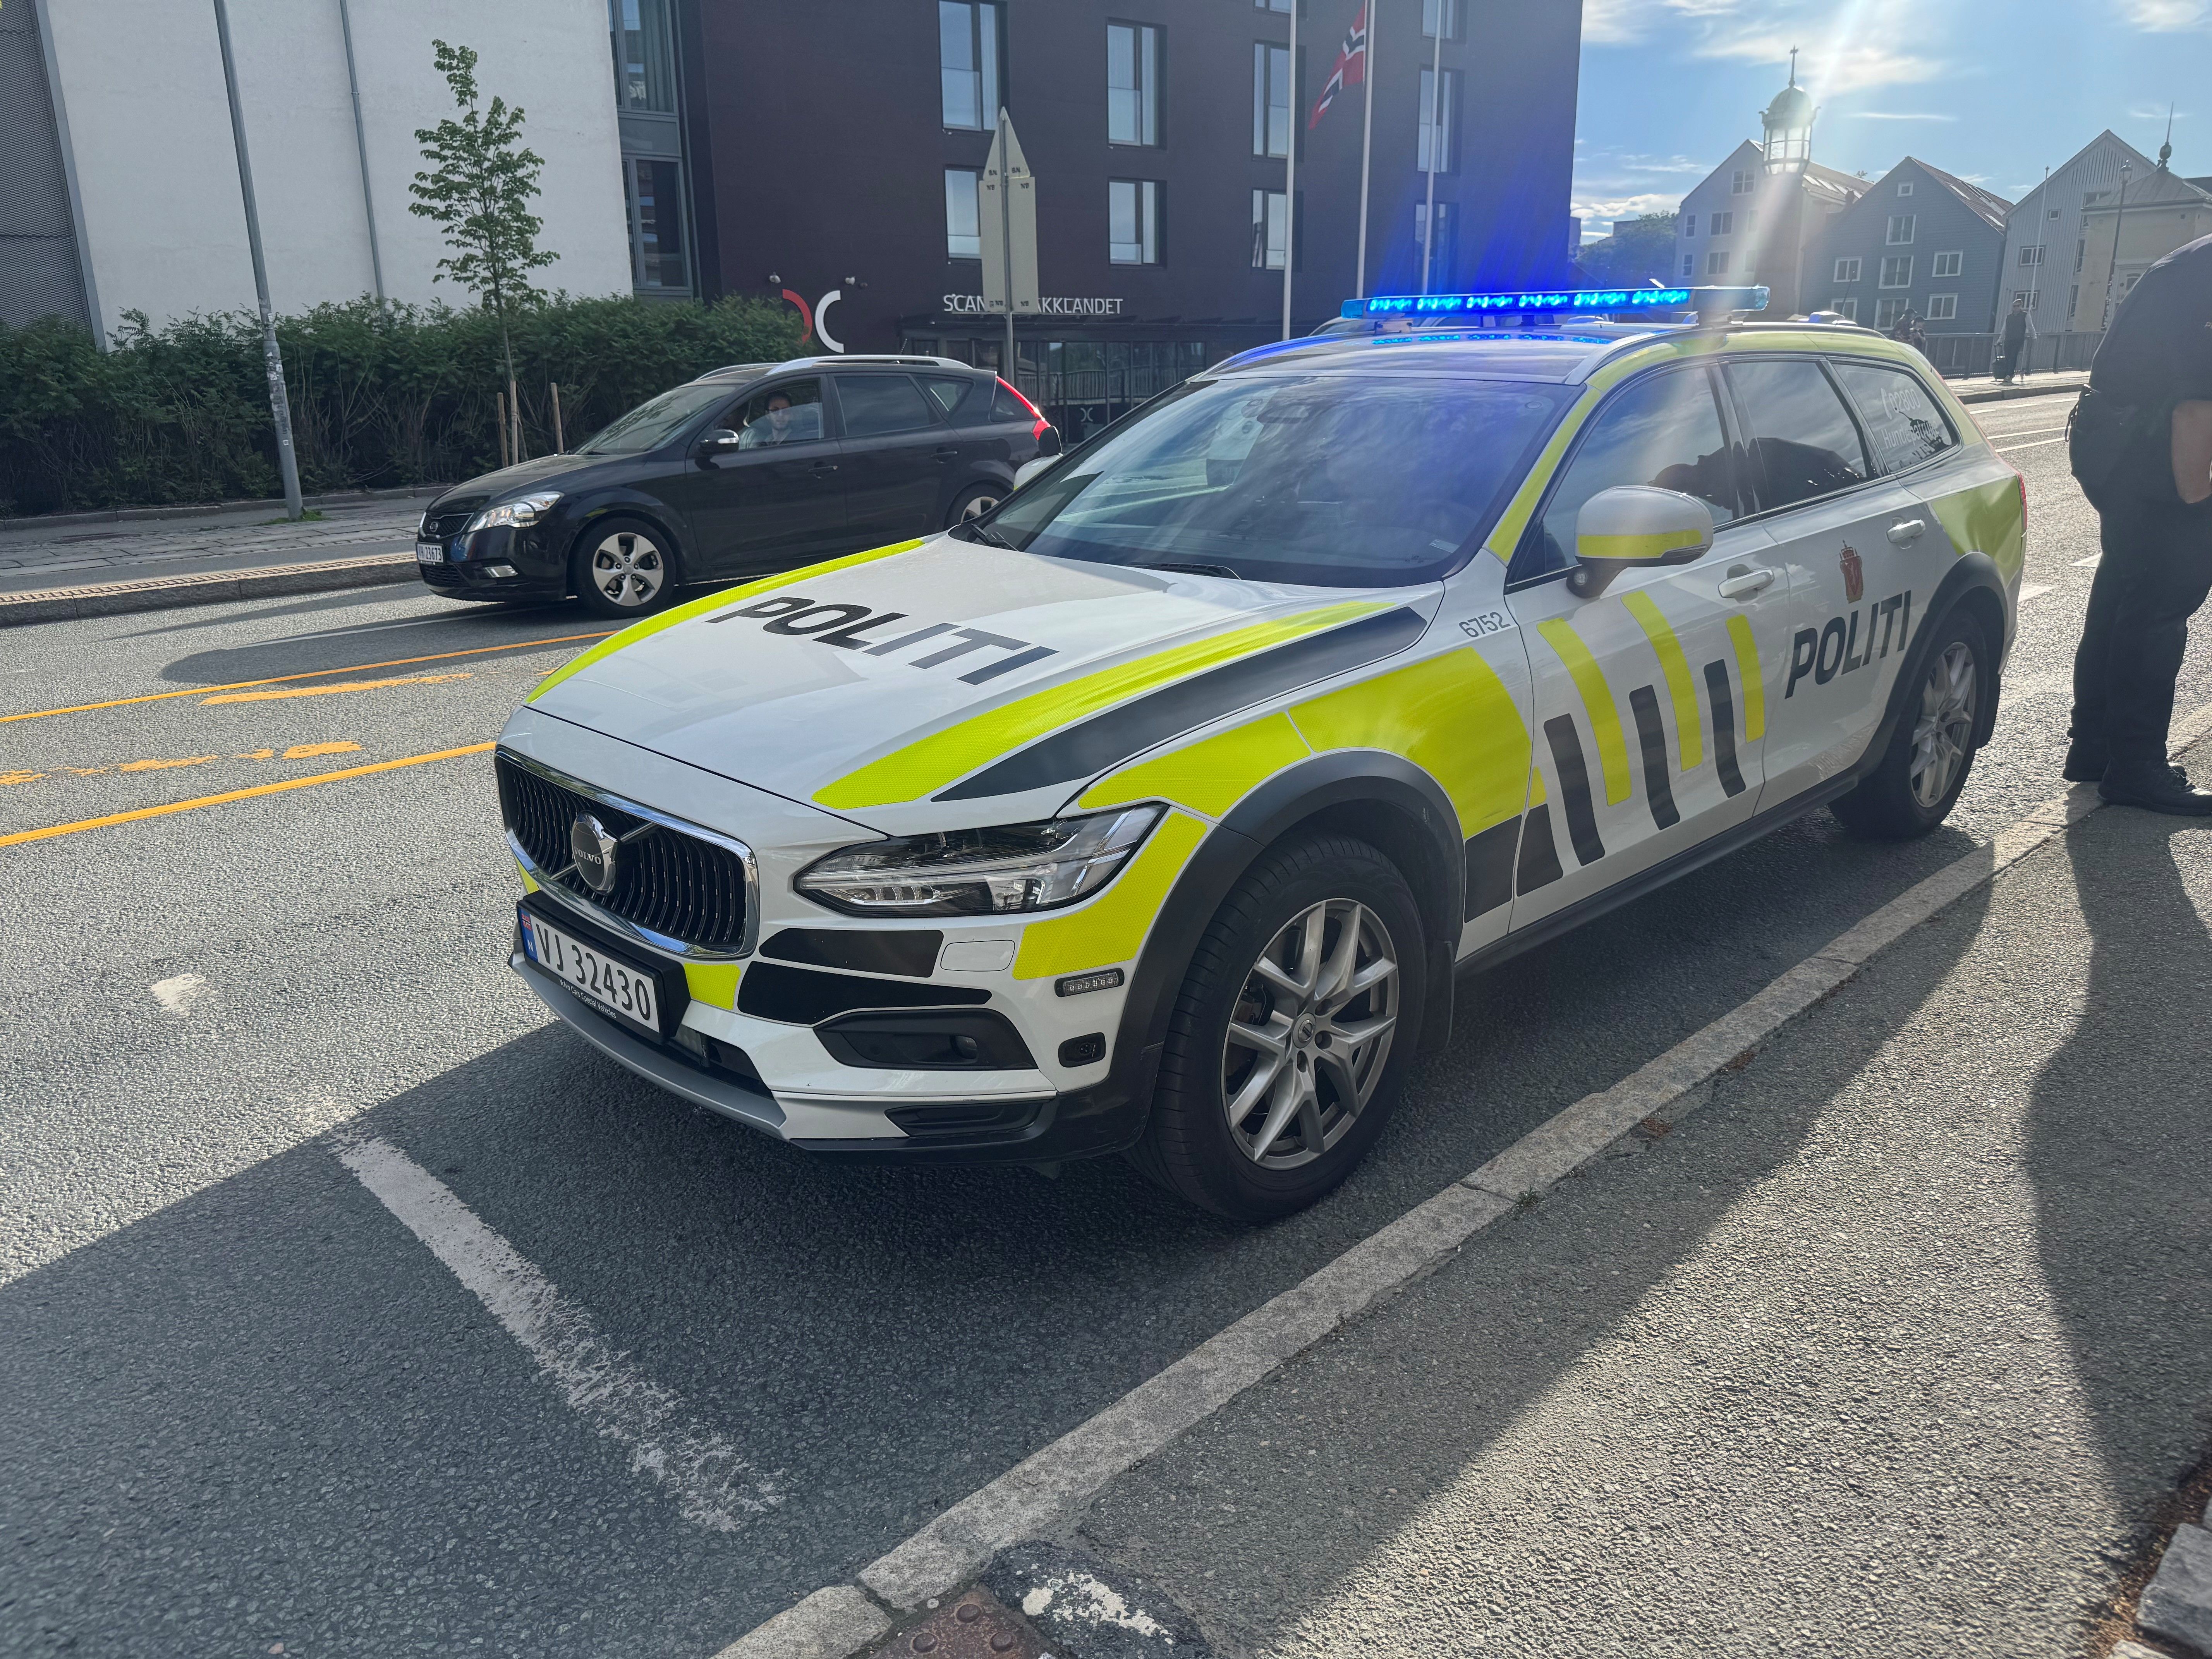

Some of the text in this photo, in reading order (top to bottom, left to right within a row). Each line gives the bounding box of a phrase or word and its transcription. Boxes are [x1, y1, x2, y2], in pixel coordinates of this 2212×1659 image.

[943, 295, 984, 311] SCAN
[1038, 297, 1123, 314] KKLANDET
[1888, 388, 1920, 413] 02800
[1458, 611, 1511, 637] 6752
[704, 596, 1060, 687] POLITI
[1784, 590, 1911, 699] POLITI
[574, 846, 602, 865] VOLVO
[527, 939, 534, 952] N
[536, 923, 651, 1021] VJ 32430
[559, 978, 617, 1018] Volvo Cars Special Vehicles
